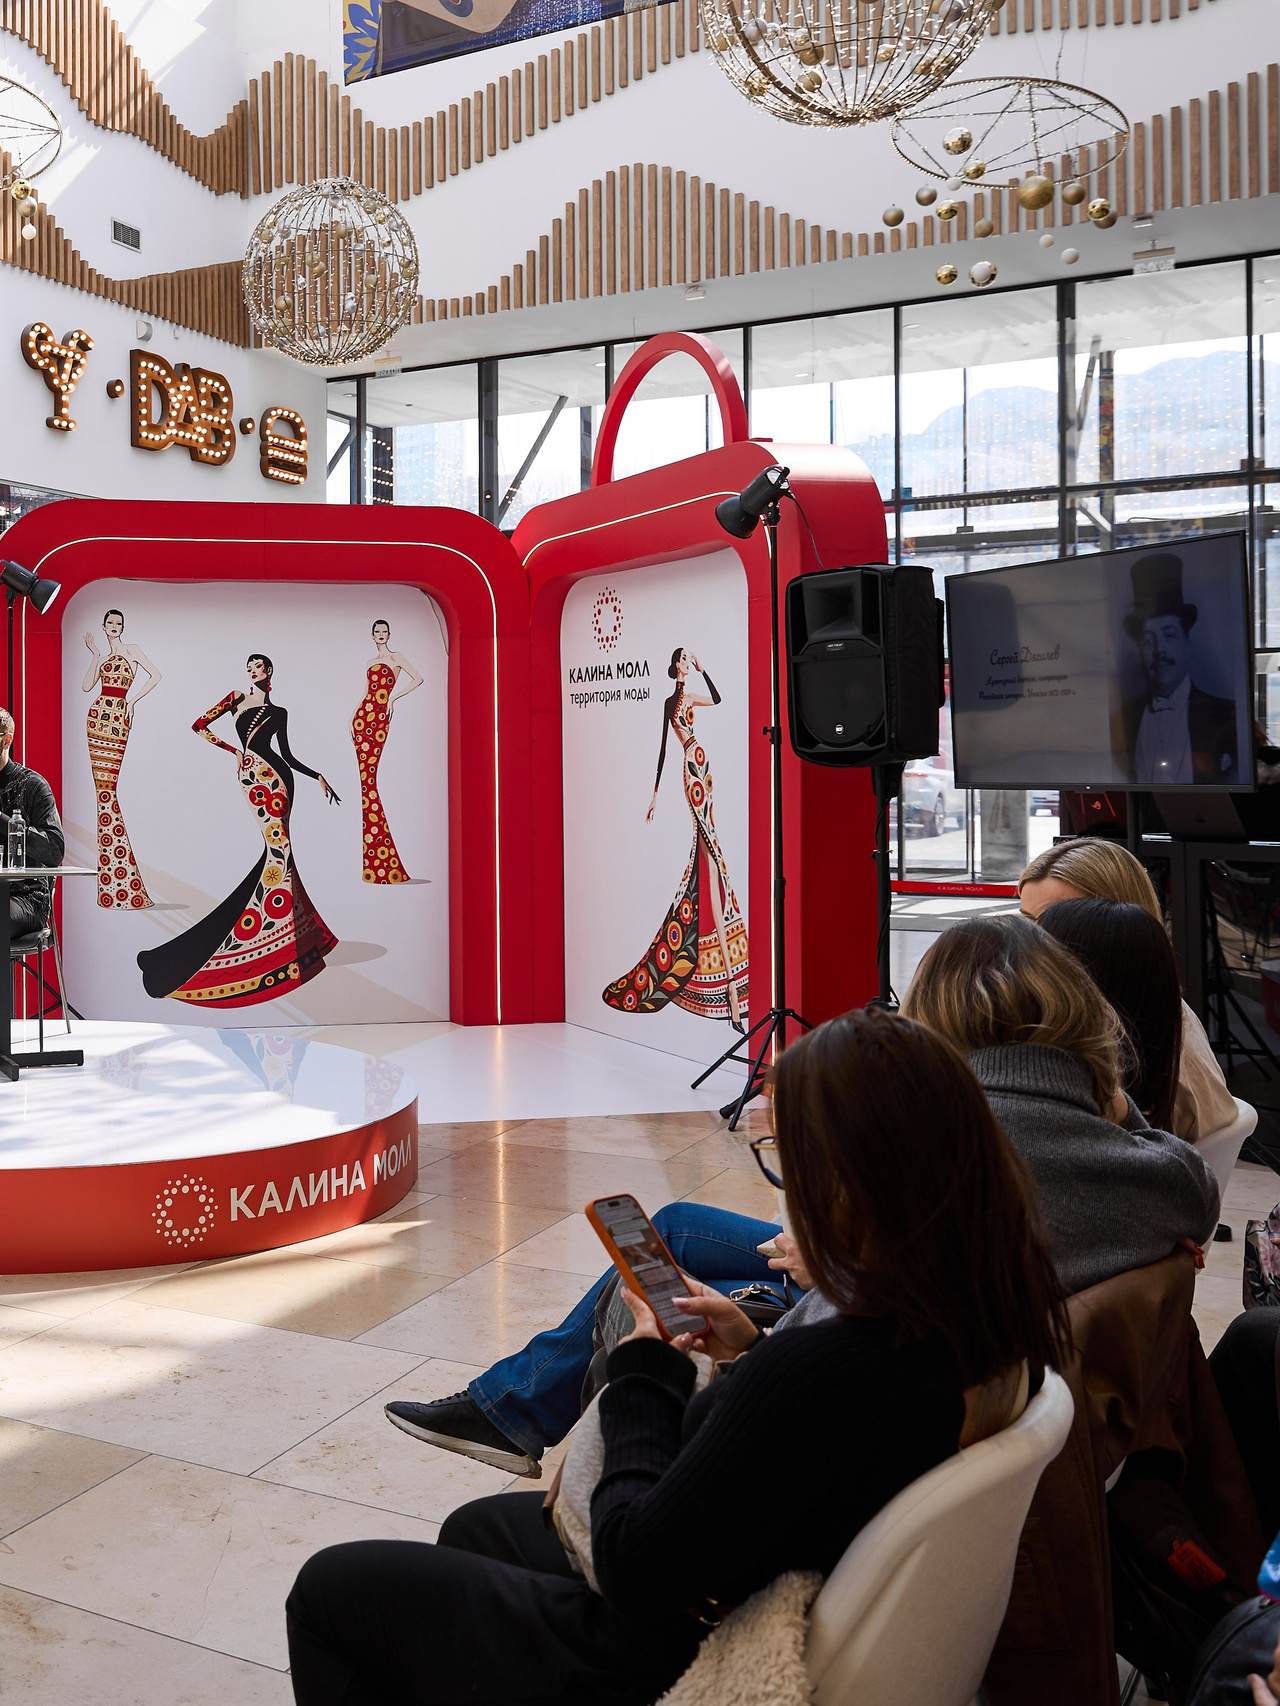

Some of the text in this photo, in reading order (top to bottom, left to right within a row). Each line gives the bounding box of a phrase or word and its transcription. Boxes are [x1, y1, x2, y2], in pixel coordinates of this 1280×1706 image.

[130, 349, 236, 466] DAB
[569, 660, 651, 684] КАЛИНА МОЛЛ
[570, 686, 650, 708] территория моды
[230, 1133, 412, 1222] КАЛИНА МОЛЛ
